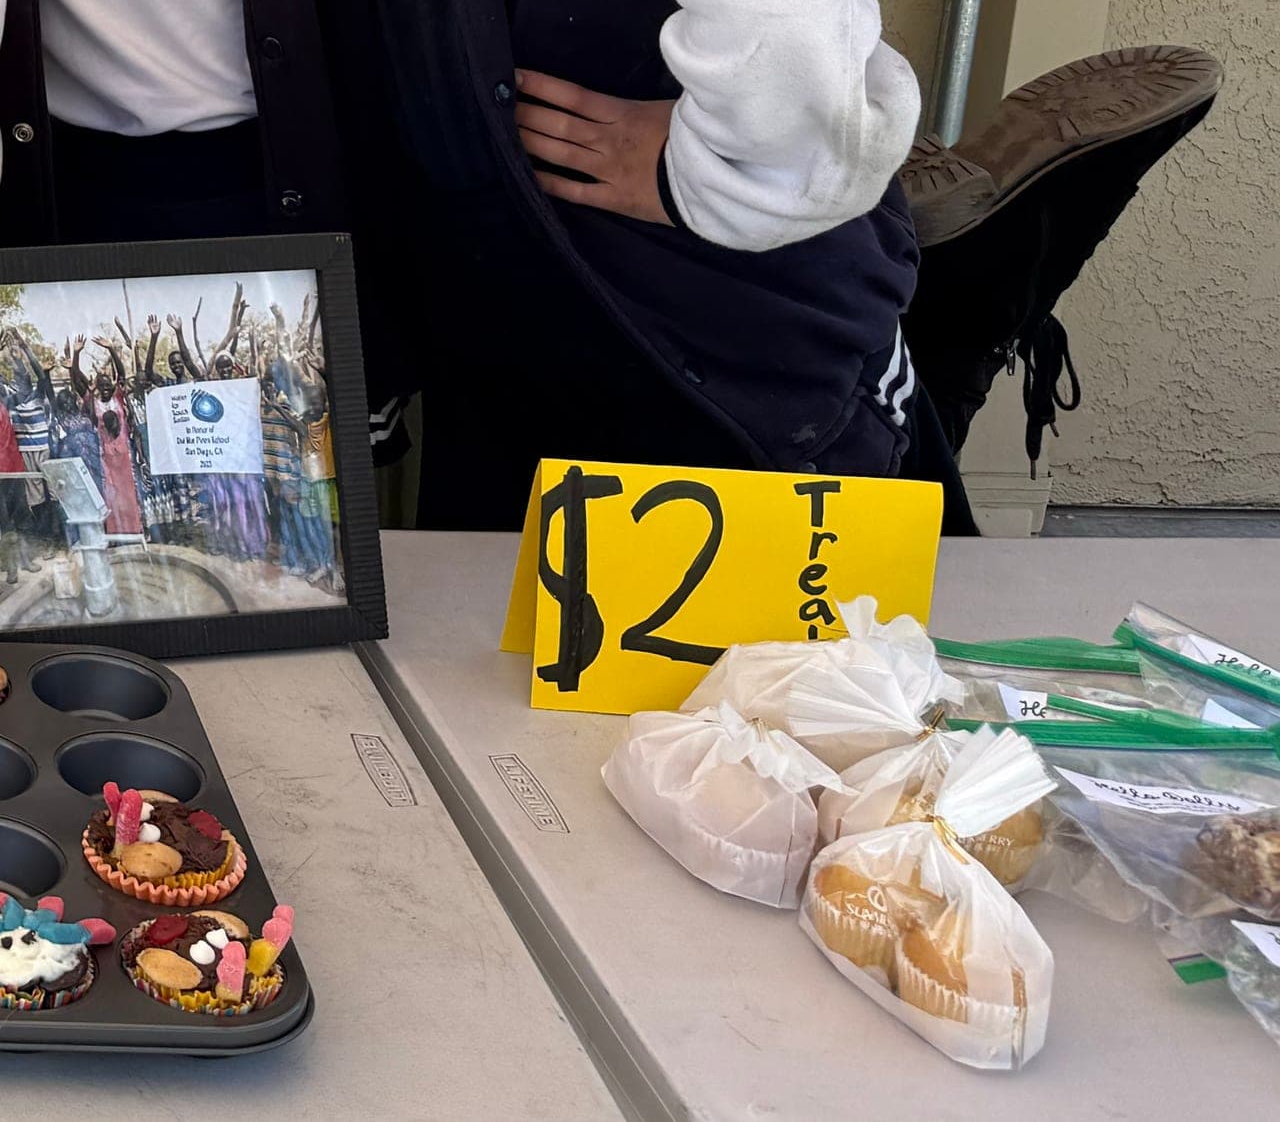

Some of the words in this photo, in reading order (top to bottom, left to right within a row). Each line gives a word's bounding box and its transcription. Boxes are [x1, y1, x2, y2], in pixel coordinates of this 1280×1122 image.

[536, 465, 729, 692] $2
[794, 480, 842, 640] Trea
[499, 762, 559, 826] LIFETIME
